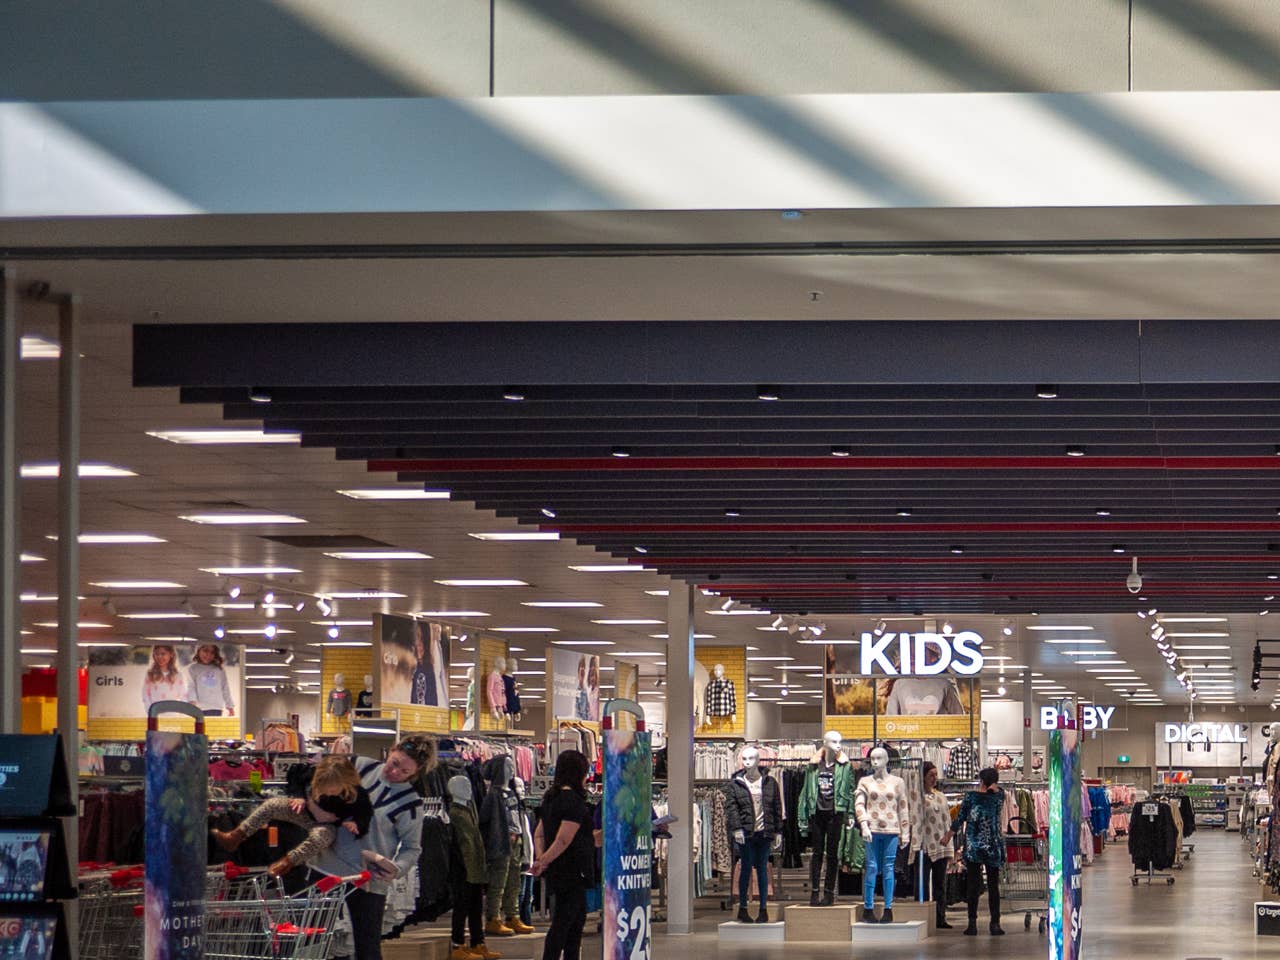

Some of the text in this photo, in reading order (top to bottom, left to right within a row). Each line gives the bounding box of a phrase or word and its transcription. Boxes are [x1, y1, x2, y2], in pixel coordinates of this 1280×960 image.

[861, 632, 983, 675] KIDS
[96, 675, 124, 686] Girls
[1040, 706, 1116, 730] BBY
[1164, 724, 1247, 742] DIGITAL
[636, 835, 649, 850] ALL
[617, 873, 651, 890] KNITWE
